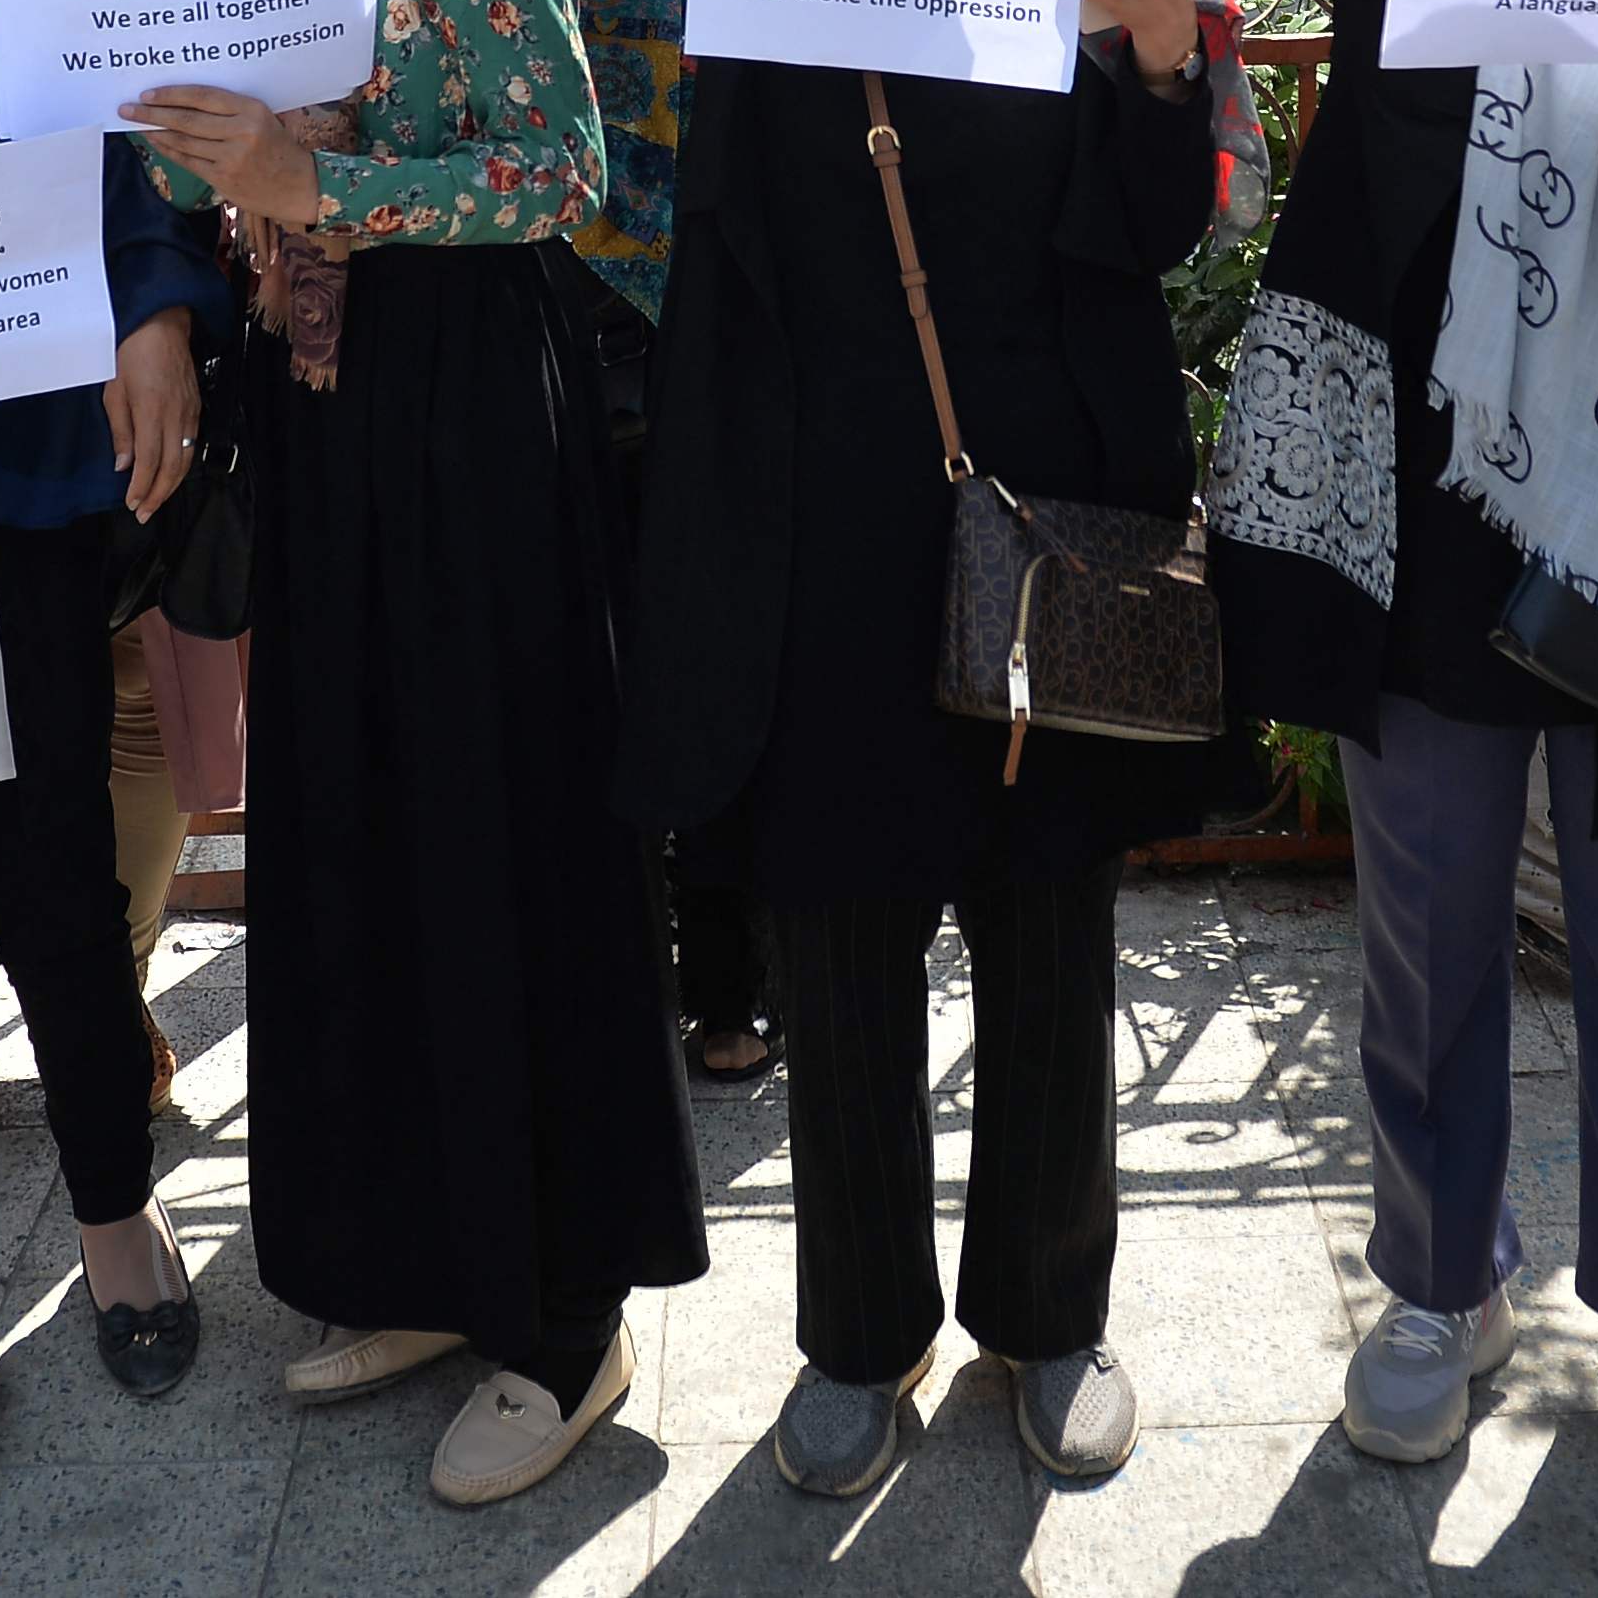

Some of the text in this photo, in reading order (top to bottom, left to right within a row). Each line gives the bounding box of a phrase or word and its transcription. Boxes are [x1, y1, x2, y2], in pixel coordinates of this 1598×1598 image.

[91, 9, 132, 30] We
[137, 9, 176, 27] are
[182, 0, 210, 23] all
[61, 22, 345, 72] We broke the oppression
